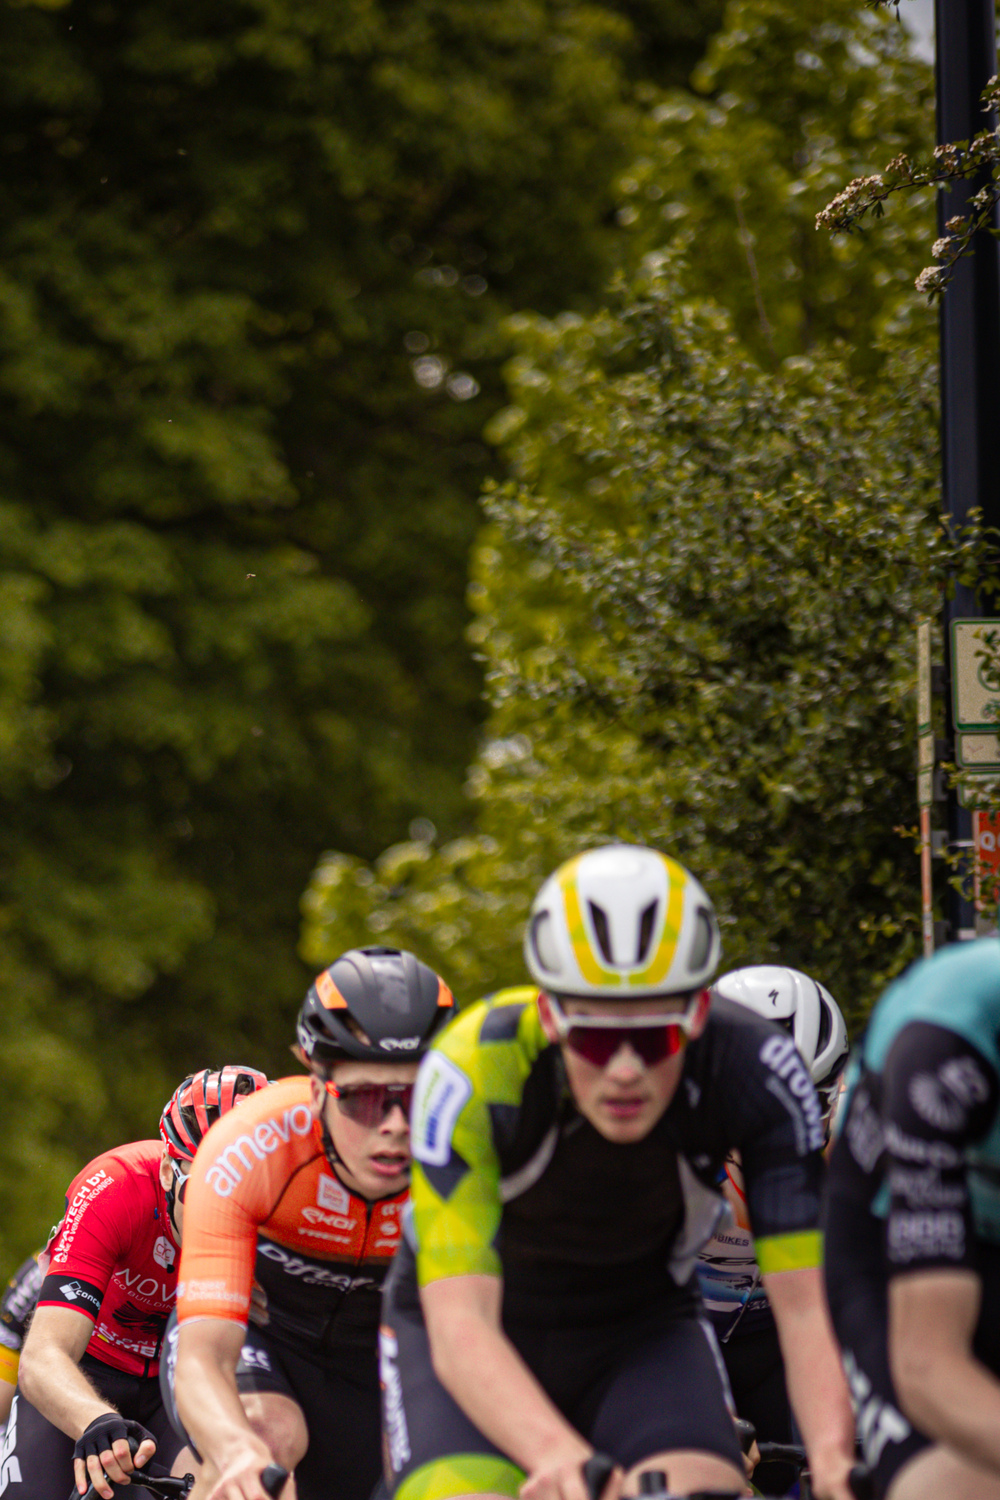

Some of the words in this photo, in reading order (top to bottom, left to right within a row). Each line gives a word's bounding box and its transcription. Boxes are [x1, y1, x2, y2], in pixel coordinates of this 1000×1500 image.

[85, 1169, 108, 1188] bv
[205, 1104, 313, 1198] amevo
[70, 1199, 91, 1236] VENTILATIE
[88, 1175, 115, 1202] TECHNIEK
